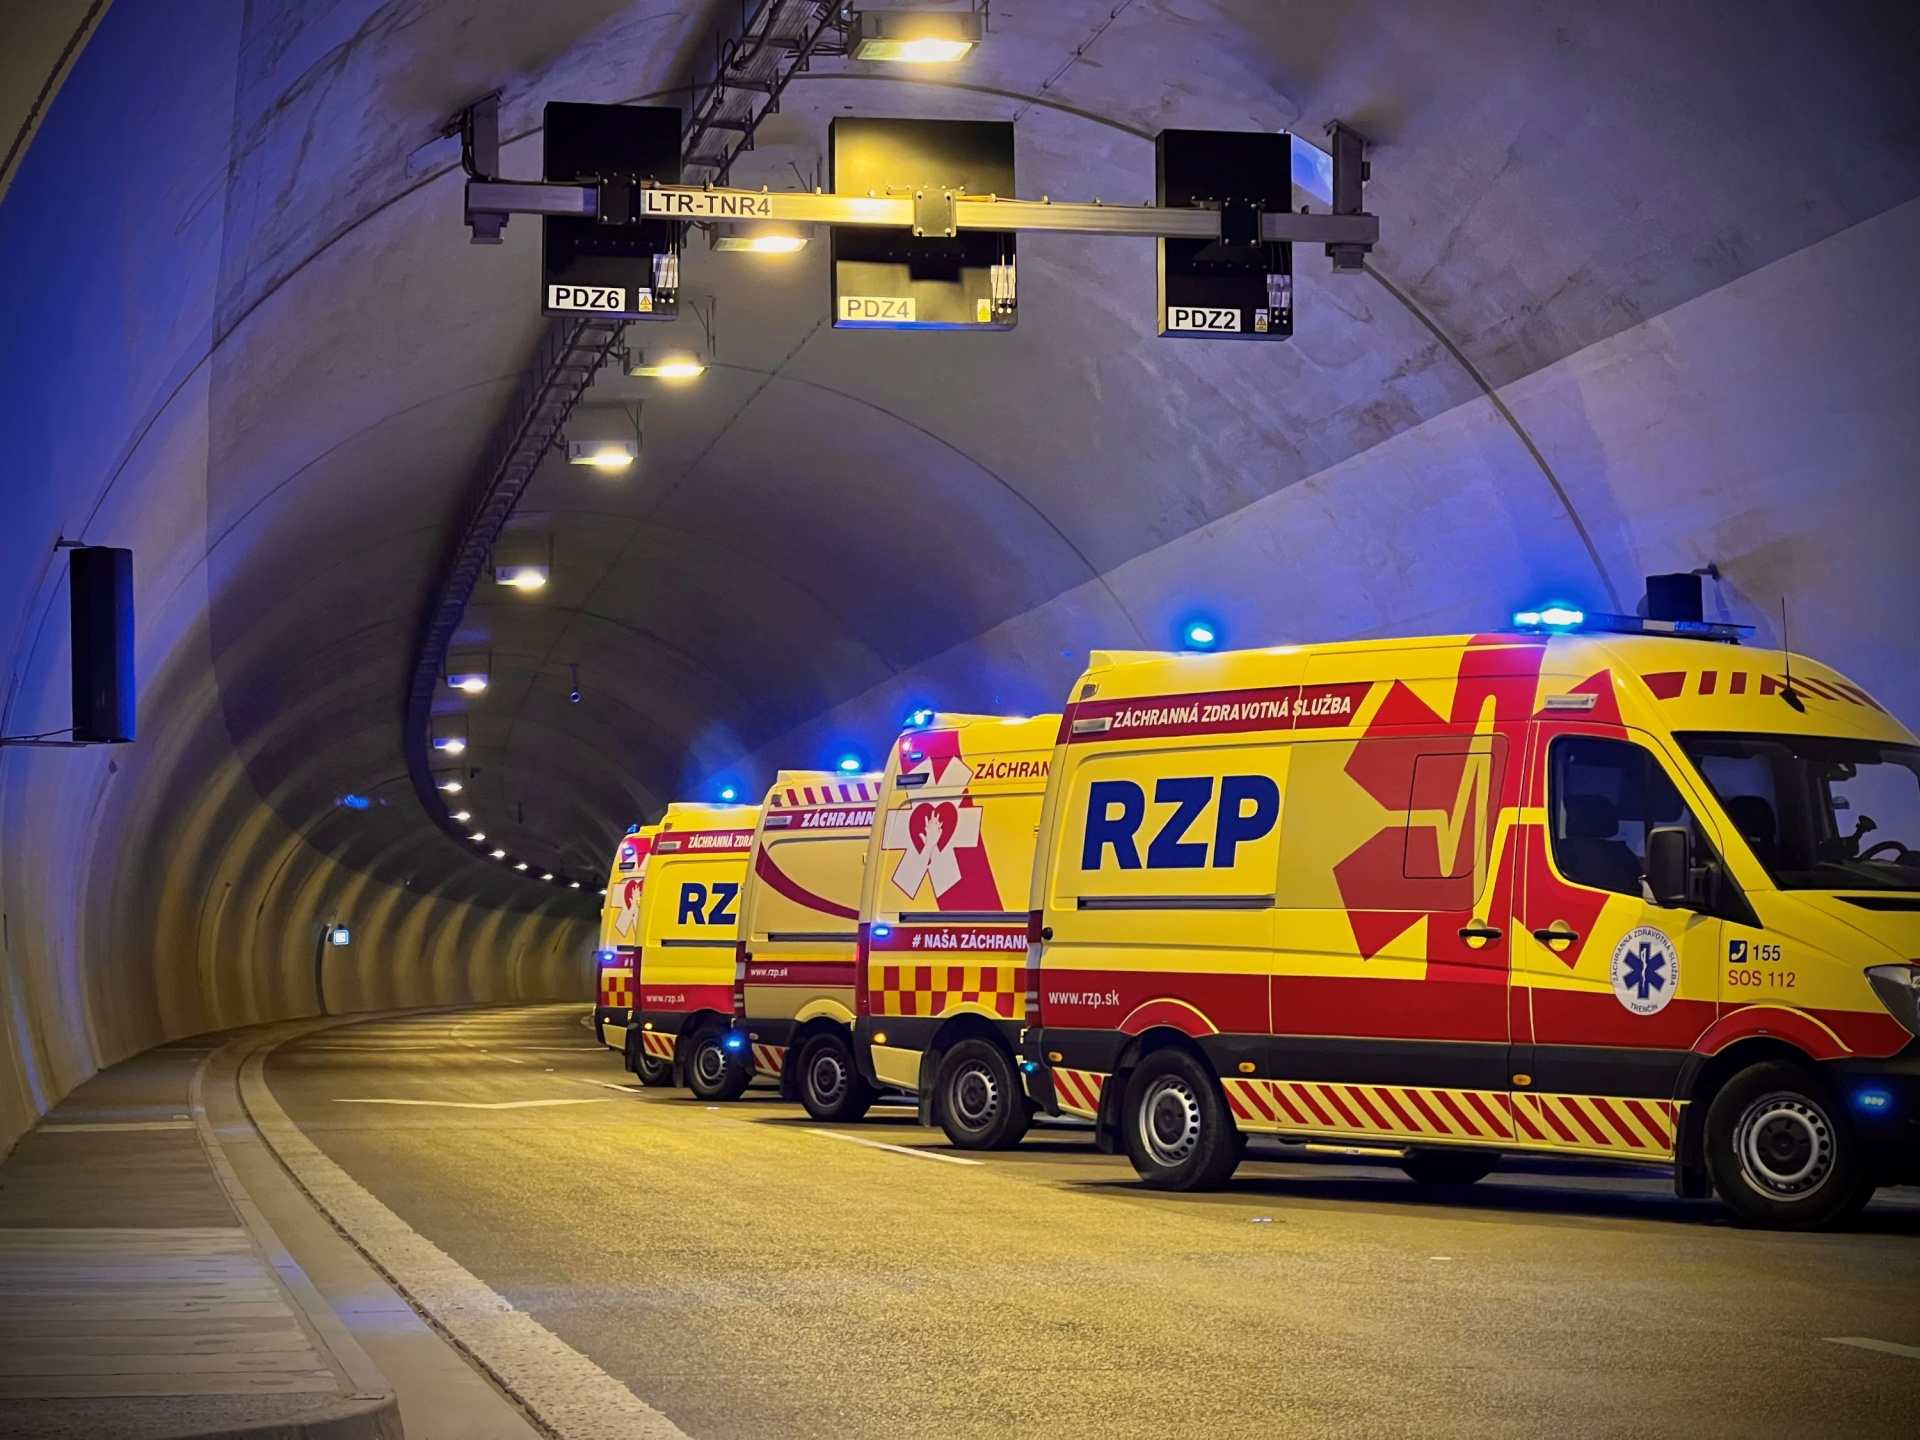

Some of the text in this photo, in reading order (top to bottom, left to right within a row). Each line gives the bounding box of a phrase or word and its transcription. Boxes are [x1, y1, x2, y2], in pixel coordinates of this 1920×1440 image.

[648, 192, 771, 216] LTR-TNR4
[555, 287, 619, 309] PDZ6
[847, 299, 910, 318] PDZ4
[1174, 309, 1236, 329] PDZ2
[1113, 693, 1352, 728] ZÁCHRANNÁ ZDRAVOTNÁ SLUŽBA
[1081, 774, 1281, 870] RZP
[688, 832, 734, 849] ZÁCHRANNÁ
[677, 882, 739, 925] RZ
[911, 934, 921, 948] #
[924, 929, 957, 949] NAŠA
[1753, 944, 1781, 961] 155
[751, 967, 788, 979] www.rzp.sk
[1728, 969, 1796, 988] SOS 112
[1048, 989, 1120, 1009] www.rzp.sk
